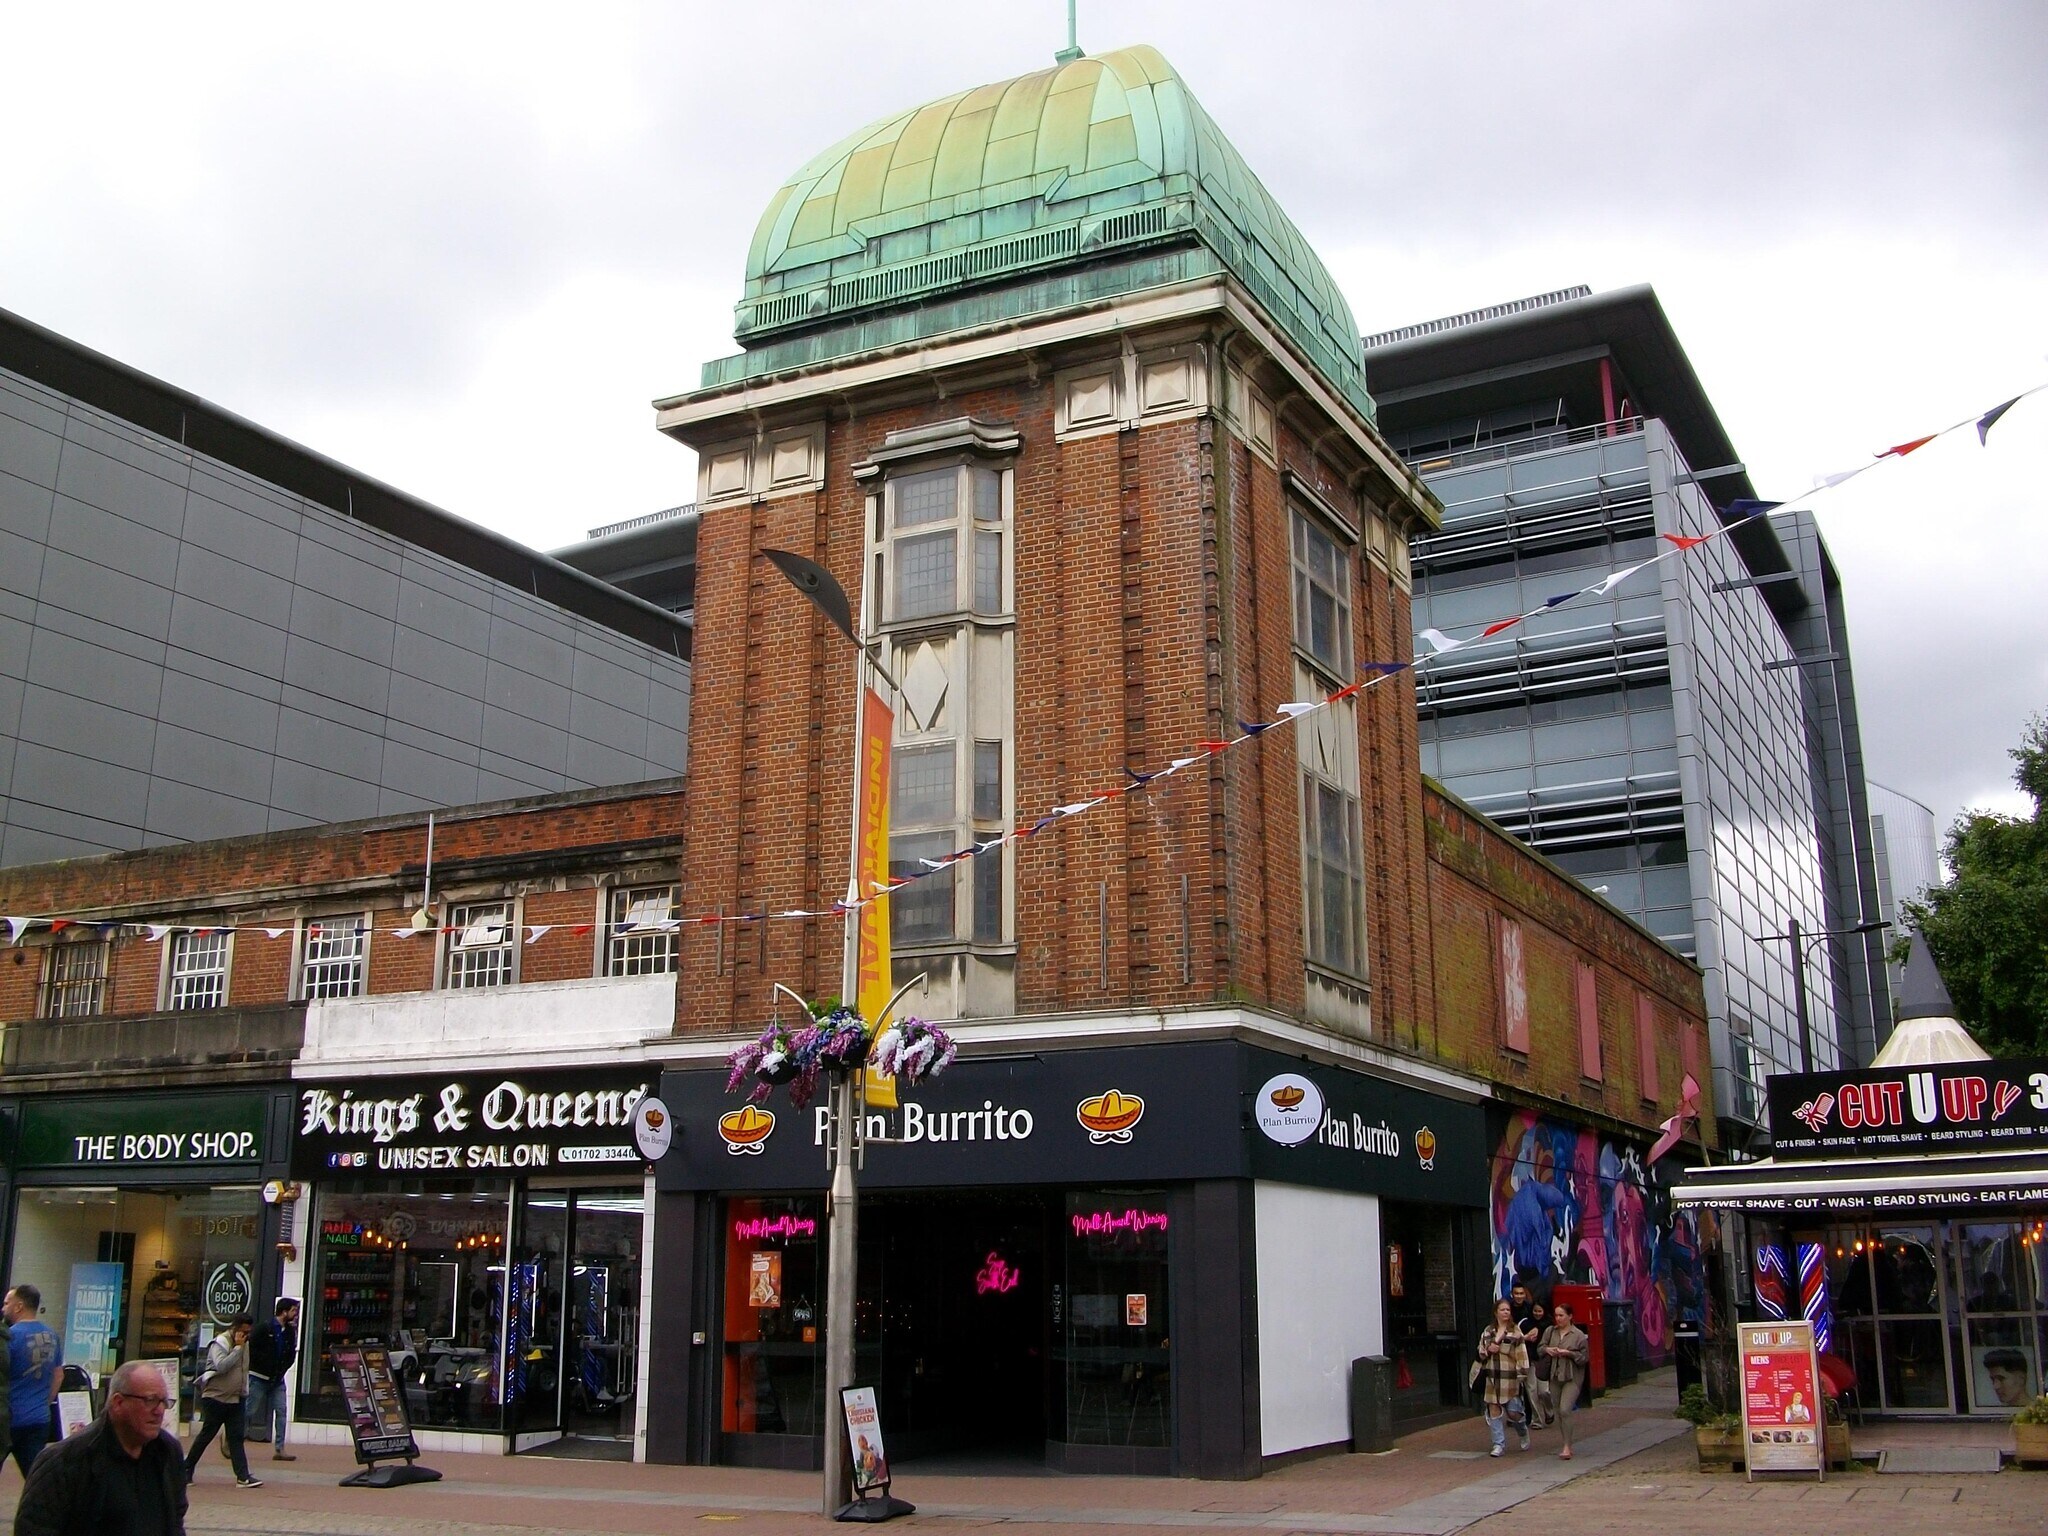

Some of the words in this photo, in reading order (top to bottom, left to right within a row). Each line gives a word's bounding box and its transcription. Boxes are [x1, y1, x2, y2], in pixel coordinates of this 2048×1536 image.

[1838, 1081, 1903, 1128] CUT
[1908, 1072, 1937, 1123] U
[1941, 1077, 1987, 1122] UP
[300, 1088, 425, 1143] Kings
[431, 1082, 472, 1133] &
[482, 1080, 648, 1133] Queens
[814, 1106, 886, 1145] Pn
[903, 1100, 1034, 1142] Burrito
[1263, 1117, 1282, 1127] Plan
[1284, 1115, 1316, 1125] Burrito
[1353, 1112, 1399, 1157] Burrito
[1775, 1140, 1788, 1148] CUT
[1795, 1139, 1816, 1147] FINISH
[1823, 1138, 1838, 1146] SKIN
[1839, 1137, 1856, 1145] FADE
[1863, 1136, 1876, 1144] HOT
[1877, 1135, 1900, 1143] TOWEL
[1901, 1133, 1923, 1142] SHAVE
[1931, 1131, 1954, 1140] BEARD
[1955, 1130, 1984, 1138] STYLING
[1991, 1128, 2014, 1137] BEARD
[2015, 1127, 2032, 1135] TRIM
[75, 1135, 117, 1160] THE
[123, 1133, 186, 1159] BODY
[571, 1149, 600, 1160] 01702
[605, 1148, 635, 1159] 33440
[378, 1147, 463, 1170] UNISEX
[466, 1145, 550, 1168] SALON
[1677, 1201, 1700, 1209] HOT
[1702, 1200, 1744, 1209] TOWEL
[1746, 1199, 1785, 1209] SHAVE
[1794, 1199, 1820, 1208] CUT
[1829, 1197, 1864, 1208] WASH
[1874, 1195, 1916, 1206] BEARD
[1918, 1192, 1971, 1205] STYLING
[1980, 1191, 2006, 1202] EAR
[326, 1234, 358, 1245] NAILS
[221, 1281, 237, 1291] THE
[214, 1292, 243, 1303] BODY
[215, 1304, 241, 1314] SHOP
[1752, 1332, 1770, 1345] CUT
[1772, 1331, 1778, 1344] U
[1780, 1331, 1792, 1344] UP
[1750, 1355, 1770, 1365] MENS
